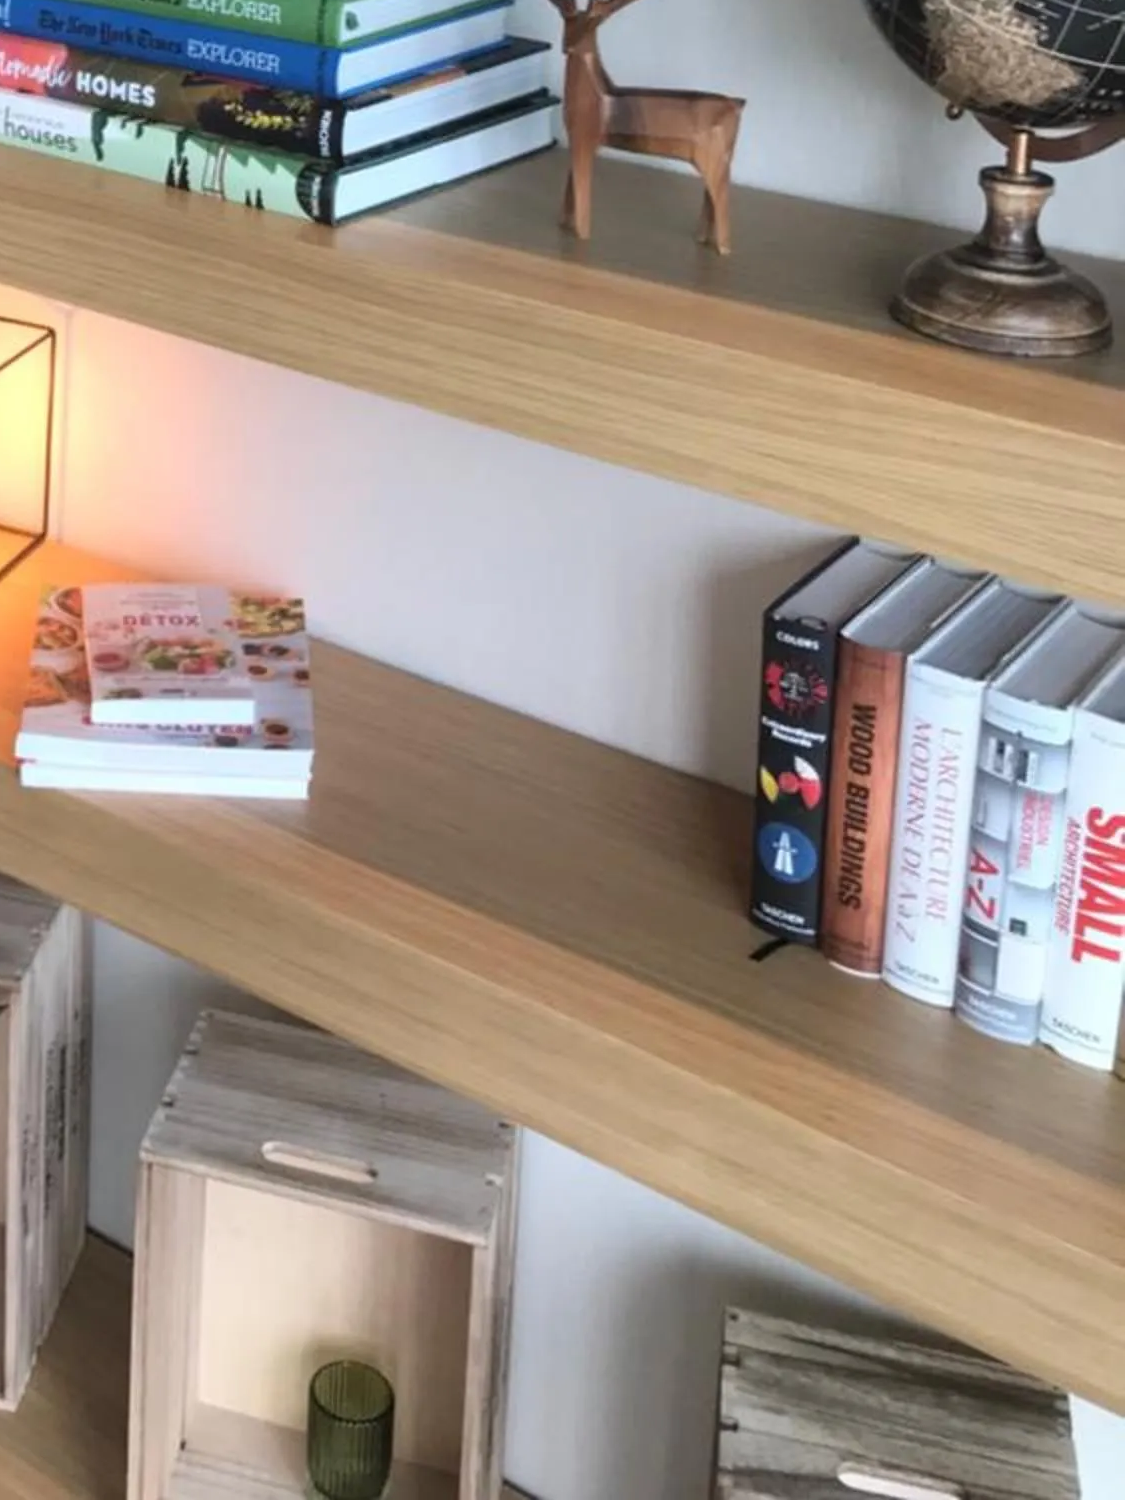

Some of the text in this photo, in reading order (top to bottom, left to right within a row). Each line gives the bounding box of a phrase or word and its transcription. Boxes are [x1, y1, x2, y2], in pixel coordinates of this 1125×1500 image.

[38, 10, 64, 32] The
[67, 16, 97, 37] New
[98, 21, 135, 46] York
[136, 27, 182, 54] Times
[187, 38, 280, 75] EXPLORER
[76, 70, 156, 108] HOMES
[4, 106, 78, 153] houses
[838, 703, 877, 910] WOOD BUILDINGS
[904, 718, 932, 841] MODERNE
[900, 847, 922, 879] DE
[967, 848, 1000, 920] A-Z
[1054, 816, 1081, 936] ARCHITECTURE
[1071, 805, 1125, 964] SMALL
[896, 920, 916, 943] Z
[1053, 1017, 1101, 1043] TASCHEN
